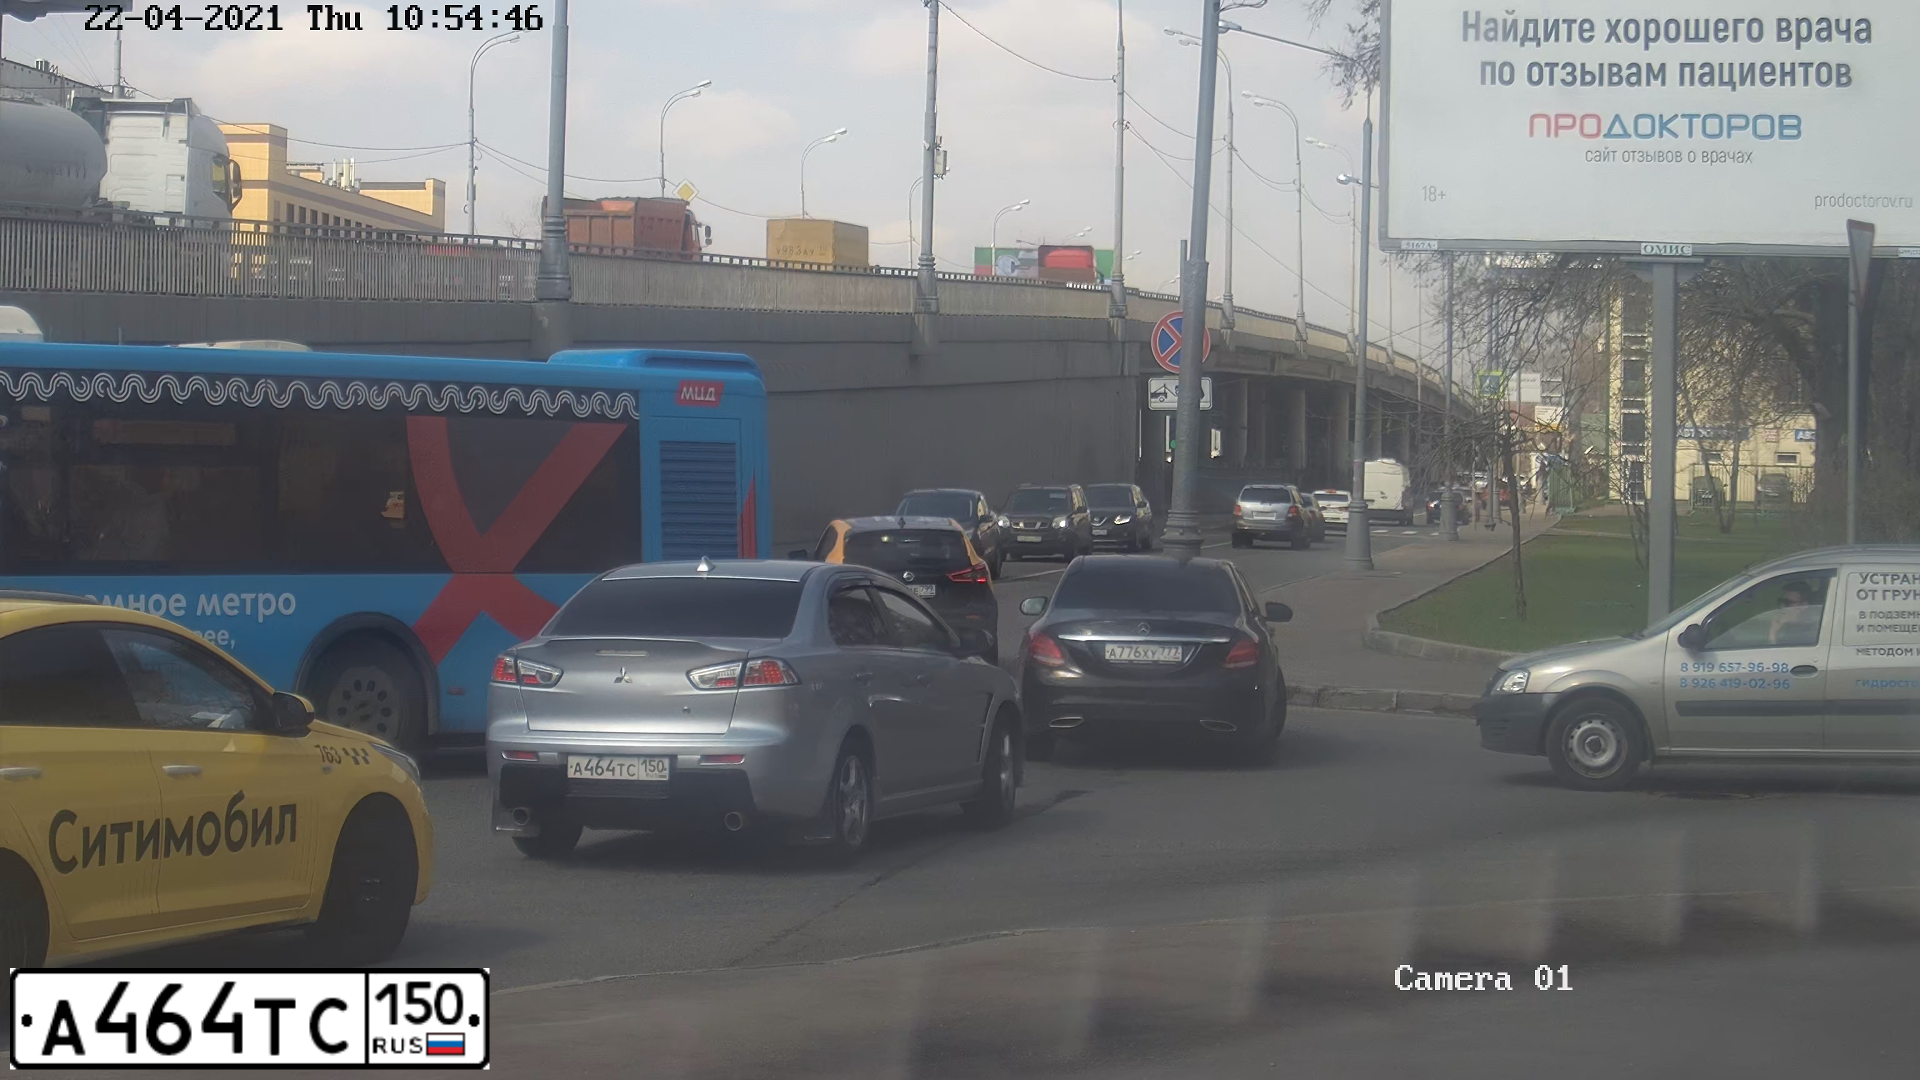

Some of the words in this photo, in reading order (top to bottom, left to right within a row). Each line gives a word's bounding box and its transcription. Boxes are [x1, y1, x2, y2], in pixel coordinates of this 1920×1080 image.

[1461, 9, 1596, 48] Найдите
[1604, 17, 1764, 51] хорошего
[1775, 16, 1873, 51] врача
[1479, 60, 1516, 87] по
[1526, 60, 1667, 88] отзывам
[1678, 61, 1853, 92] пациентов
[1528, 113, 1803, 141] ПРОДОКТОРОВ
[1584, 147, 1618, 164] сайт
[1621, 149, 1684, 164] отзывов
[1687, 150, 1697, 164] о
[1700, 150, 1754, 167] врачах
[1421, 185, 1447, 202] 18+
[1814, 193, 1914, 210] prodoctorov.ru
[1643, 244, 1691, 255] ОМИС
[680, 386, 716, 401] МЦД
[1856, 589, 1878, 600] ОТ
[84, 593, 187, 617] мное
[196, 593, 296, 623] метро
[1859, 611, 1866, 619] В
[1857, 625, 1864, 633] И
[1856, 648, 1913, 657] МЕТОДОМ
[1680, 662, 1689, 672] 8
[1692, 662, 1715, 672] 919
[1719, 662, 1790, 673] 657-96-98
[1680, 678, 1688, 688] 8
[1691, 678, 1716, 688] 926
[1720, 678, 1790, 689] 419-02-96
[314, 744, 342, 765] 763
[573, 758, 636, 777] А464ТС
[640, 759, 664, 773] 150
[49, 789, 297, 875] Ситимобил
